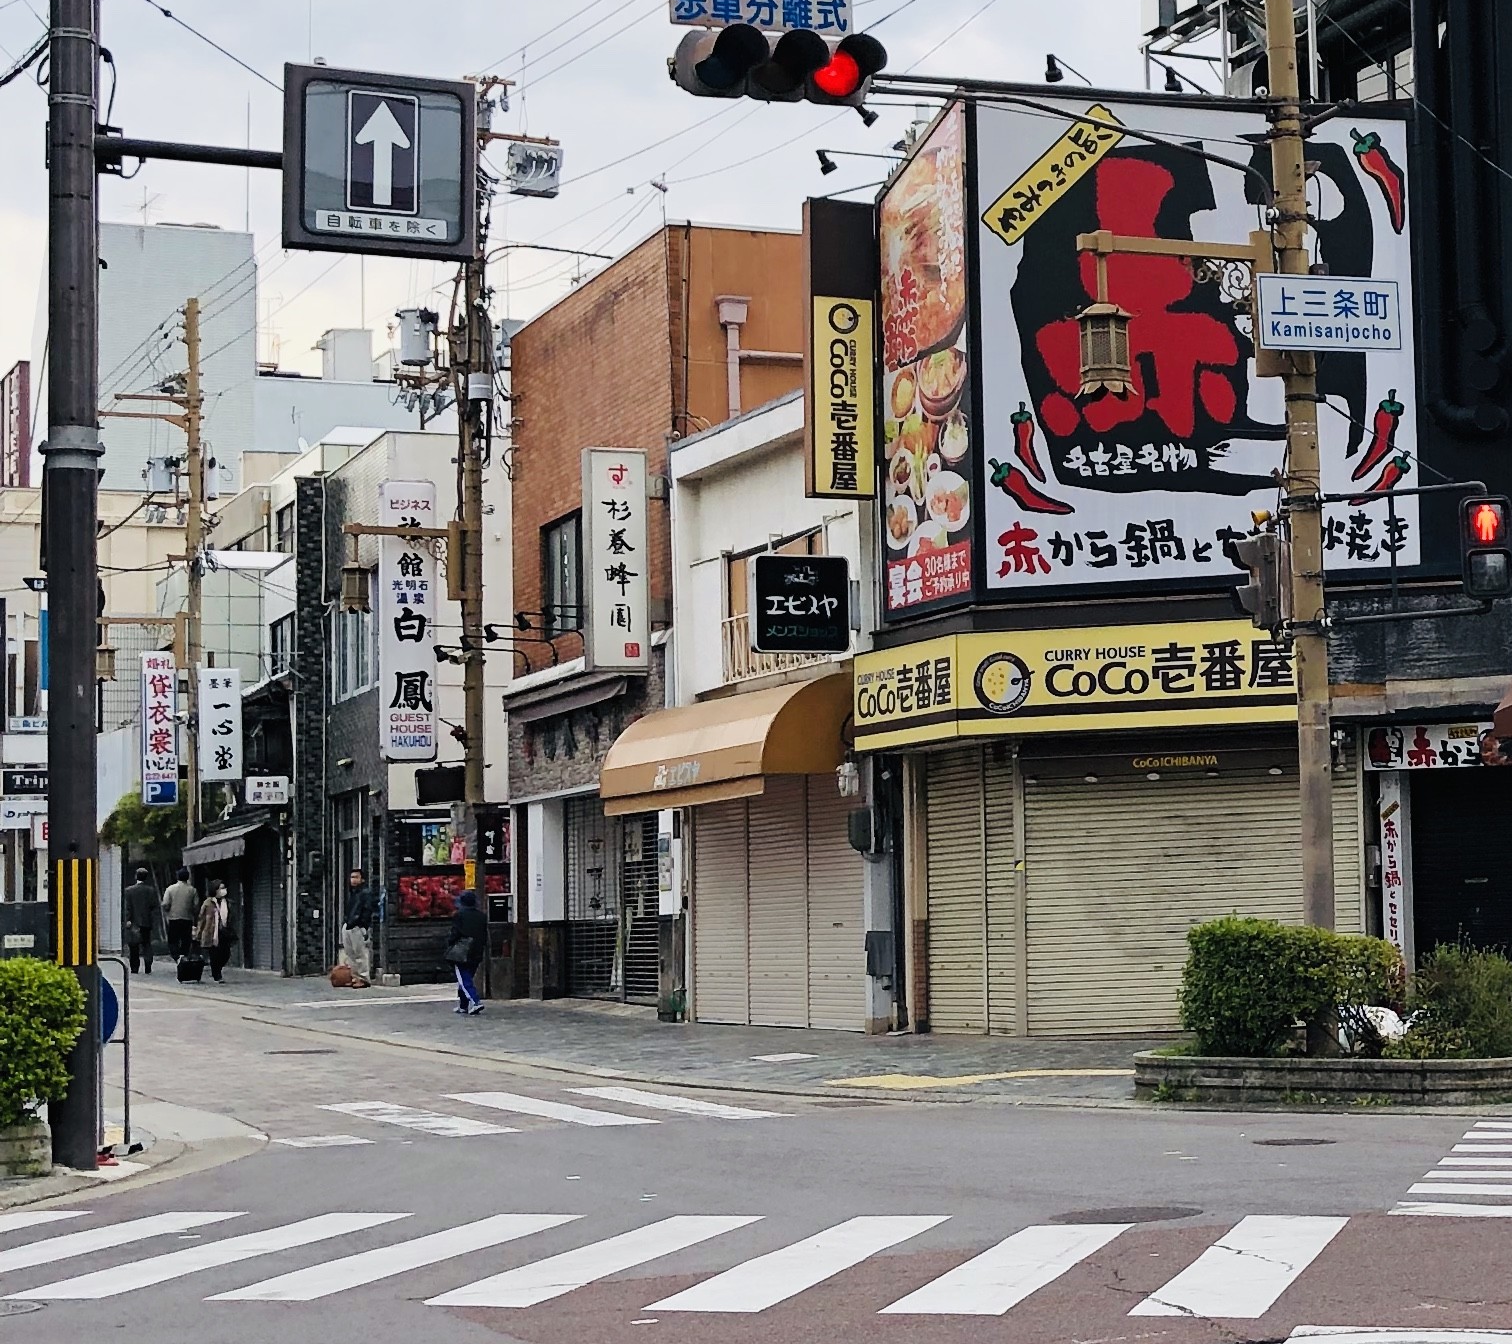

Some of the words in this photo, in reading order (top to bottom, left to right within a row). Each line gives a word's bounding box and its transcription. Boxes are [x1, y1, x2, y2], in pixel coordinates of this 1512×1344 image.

[326, 213, 437, 235] 自転車を除く
[1271, 286, 1390, 320] 上三条町
[1271, 320, 1392, 342] Kamisanjocho
[829, 338, 859, 491] CoCo壱番屋
[1063, 441, 1198, 477] 名古屋名物
[389, 498, 432, 511] ビジネス
[601, 498, 639, 633] 杉養蜂園
[391, 579, 429, 591] 光明石
[888, 560, 923, 610] 宴会
[396, 592, 425, 605] 温泉
[765, 594, 839, 618] エビスヤ
[388, 606, 434, 713] 白鳳
[1044, 647, 1092, 663] CURRY
[1095, 645, 1147, 660] HOUSE
[857, 671, 875, 685] CURRY
[875, 667, 895, 682] HOUSE
[1045, 639, 1297, 697] CoCo壱番屋
[857, 656, 952, 719] CoCo壱番屋
[148, 673, 173, 755] 貸衣裳
[389, 712, 431, 723] GUEST
[390, 724, 432, 734] HOUSE
[391, 734, 432, 748] HAKUHOU
[1132, 754, 1219, 769] CoCoICHIBANYA
[147, 783, 162, 803] P
